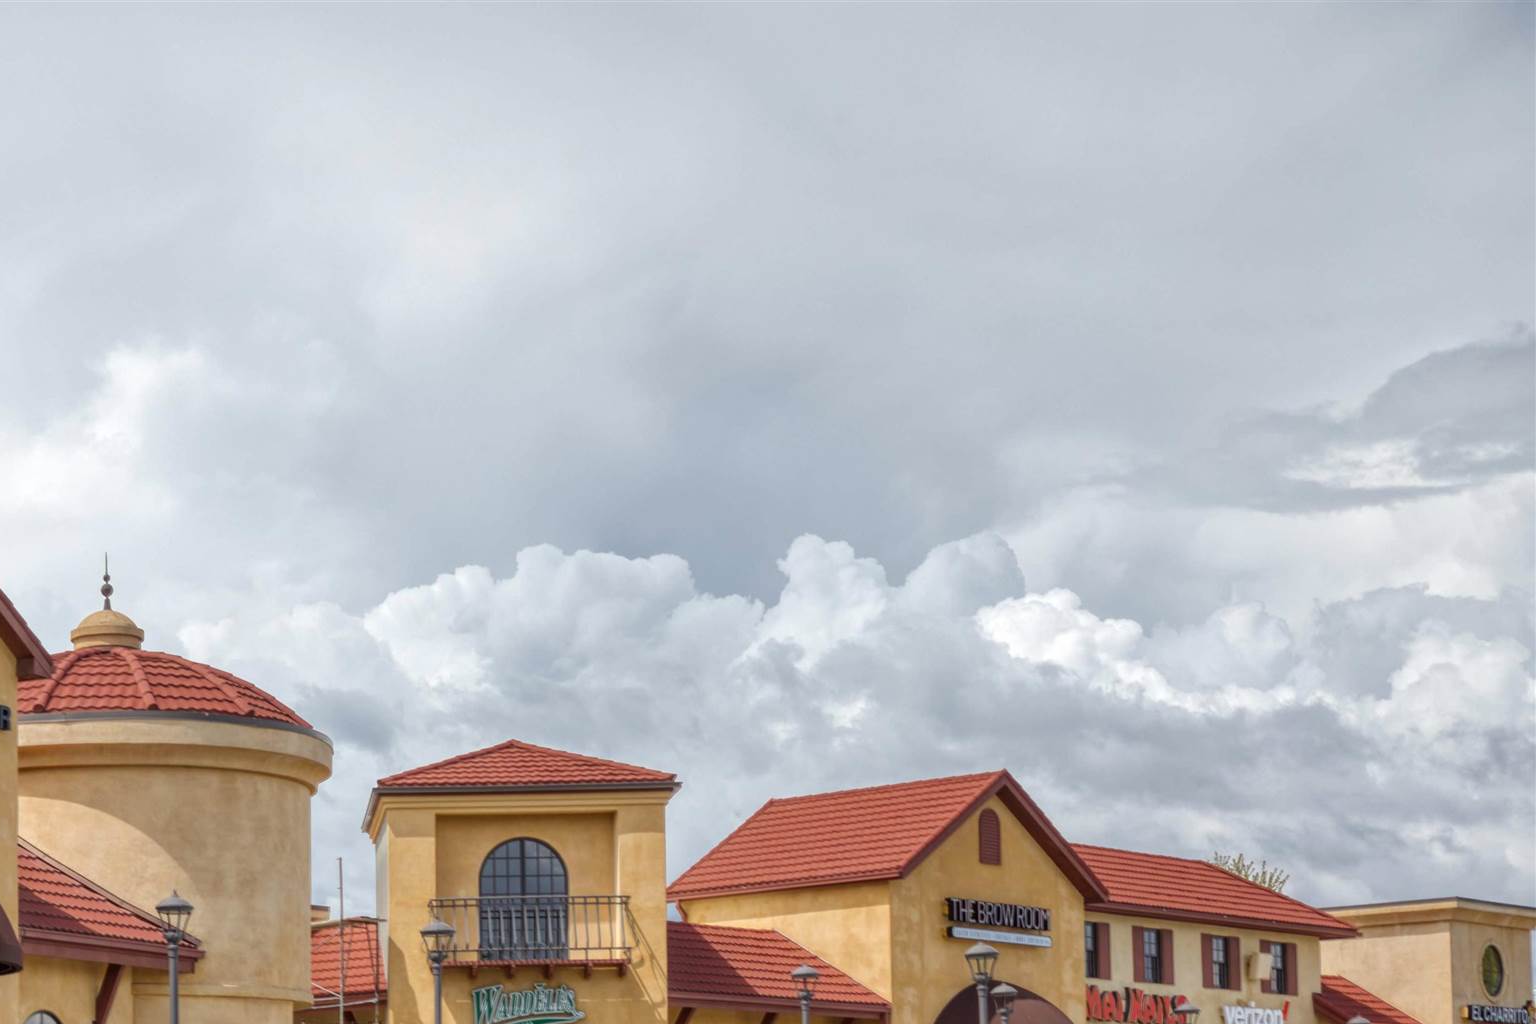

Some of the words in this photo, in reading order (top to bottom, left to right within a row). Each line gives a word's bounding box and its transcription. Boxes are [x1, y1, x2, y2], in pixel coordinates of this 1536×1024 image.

[950, 898, 976, 923] THE
[977, 901, 1015, 927] BROW
[1016, 905, 1051, 930] ROOM
[1471, 1005, 1483, 1021] EL
